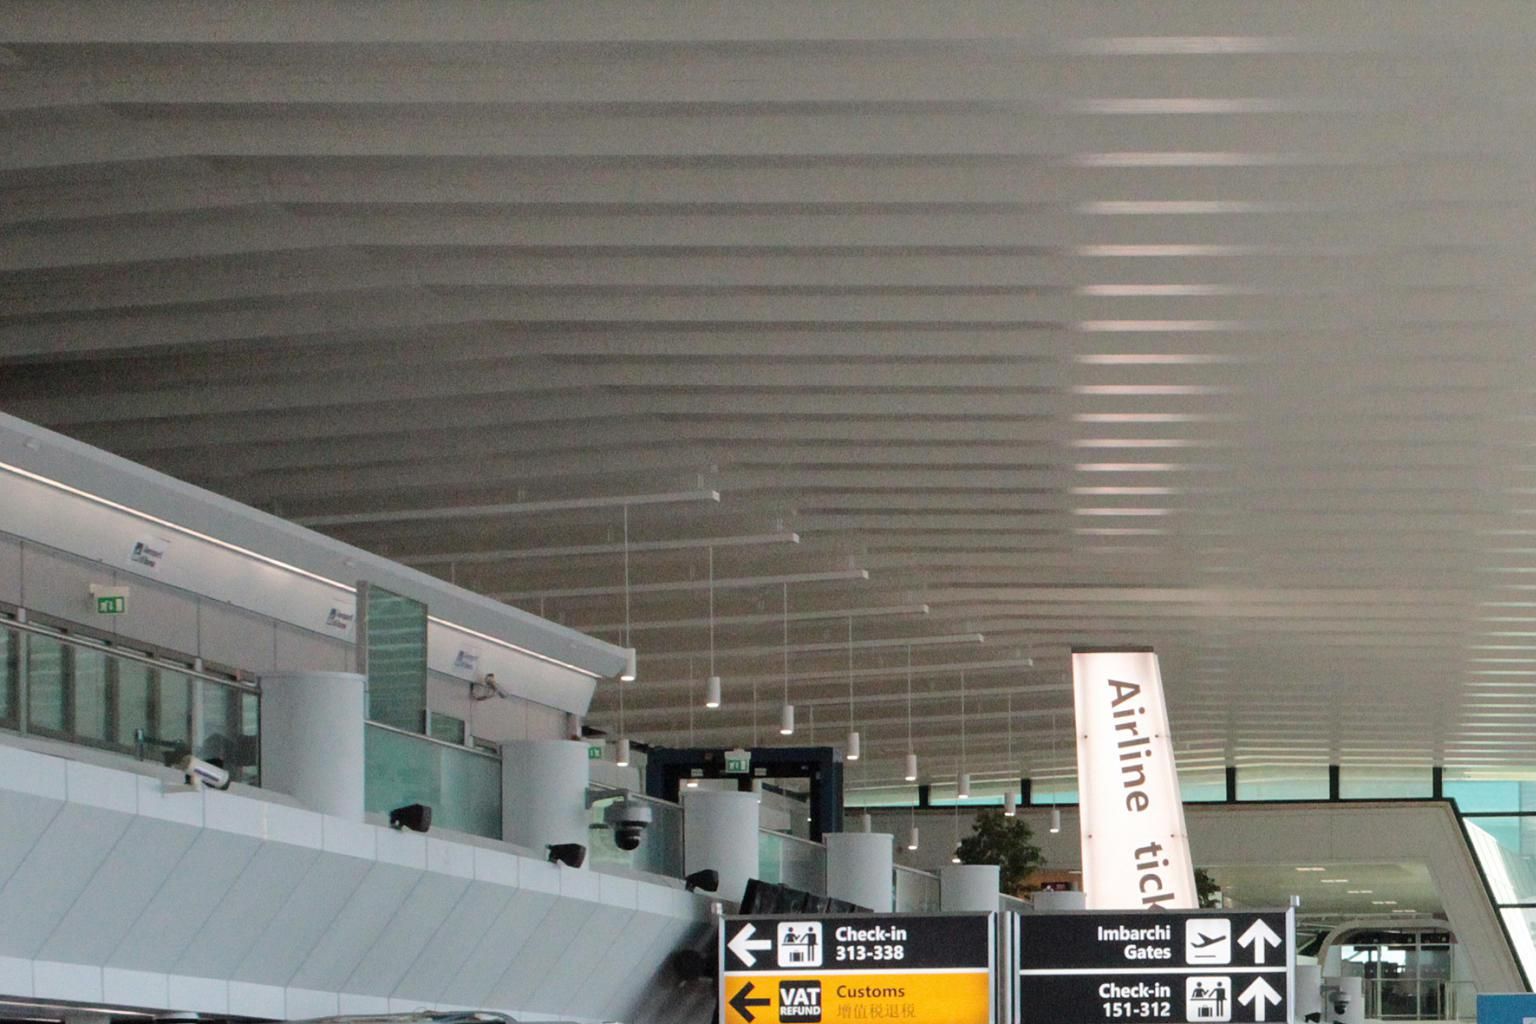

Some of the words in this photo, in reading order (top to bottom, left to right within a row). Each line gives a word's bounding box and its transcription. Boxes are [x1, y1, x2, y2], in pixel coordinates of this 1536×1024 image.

[1107, 679, 1152, 812] Airline
[835, 925, 908, 942] Check-in
[1097, 924, 1172, 941] Imbarchi
[835, 944, 905, 961] 313-338
[1123, 944, 1172, 960] Gates
[780, 987, 821, 1006] VAT
[836, 985, 906, 998] Customs
[1098, 982, 1171, 998] Check-in
[780, 1006, 821, 1016] REFUND
[1103, 1002, 1171, 1017] 151-312
